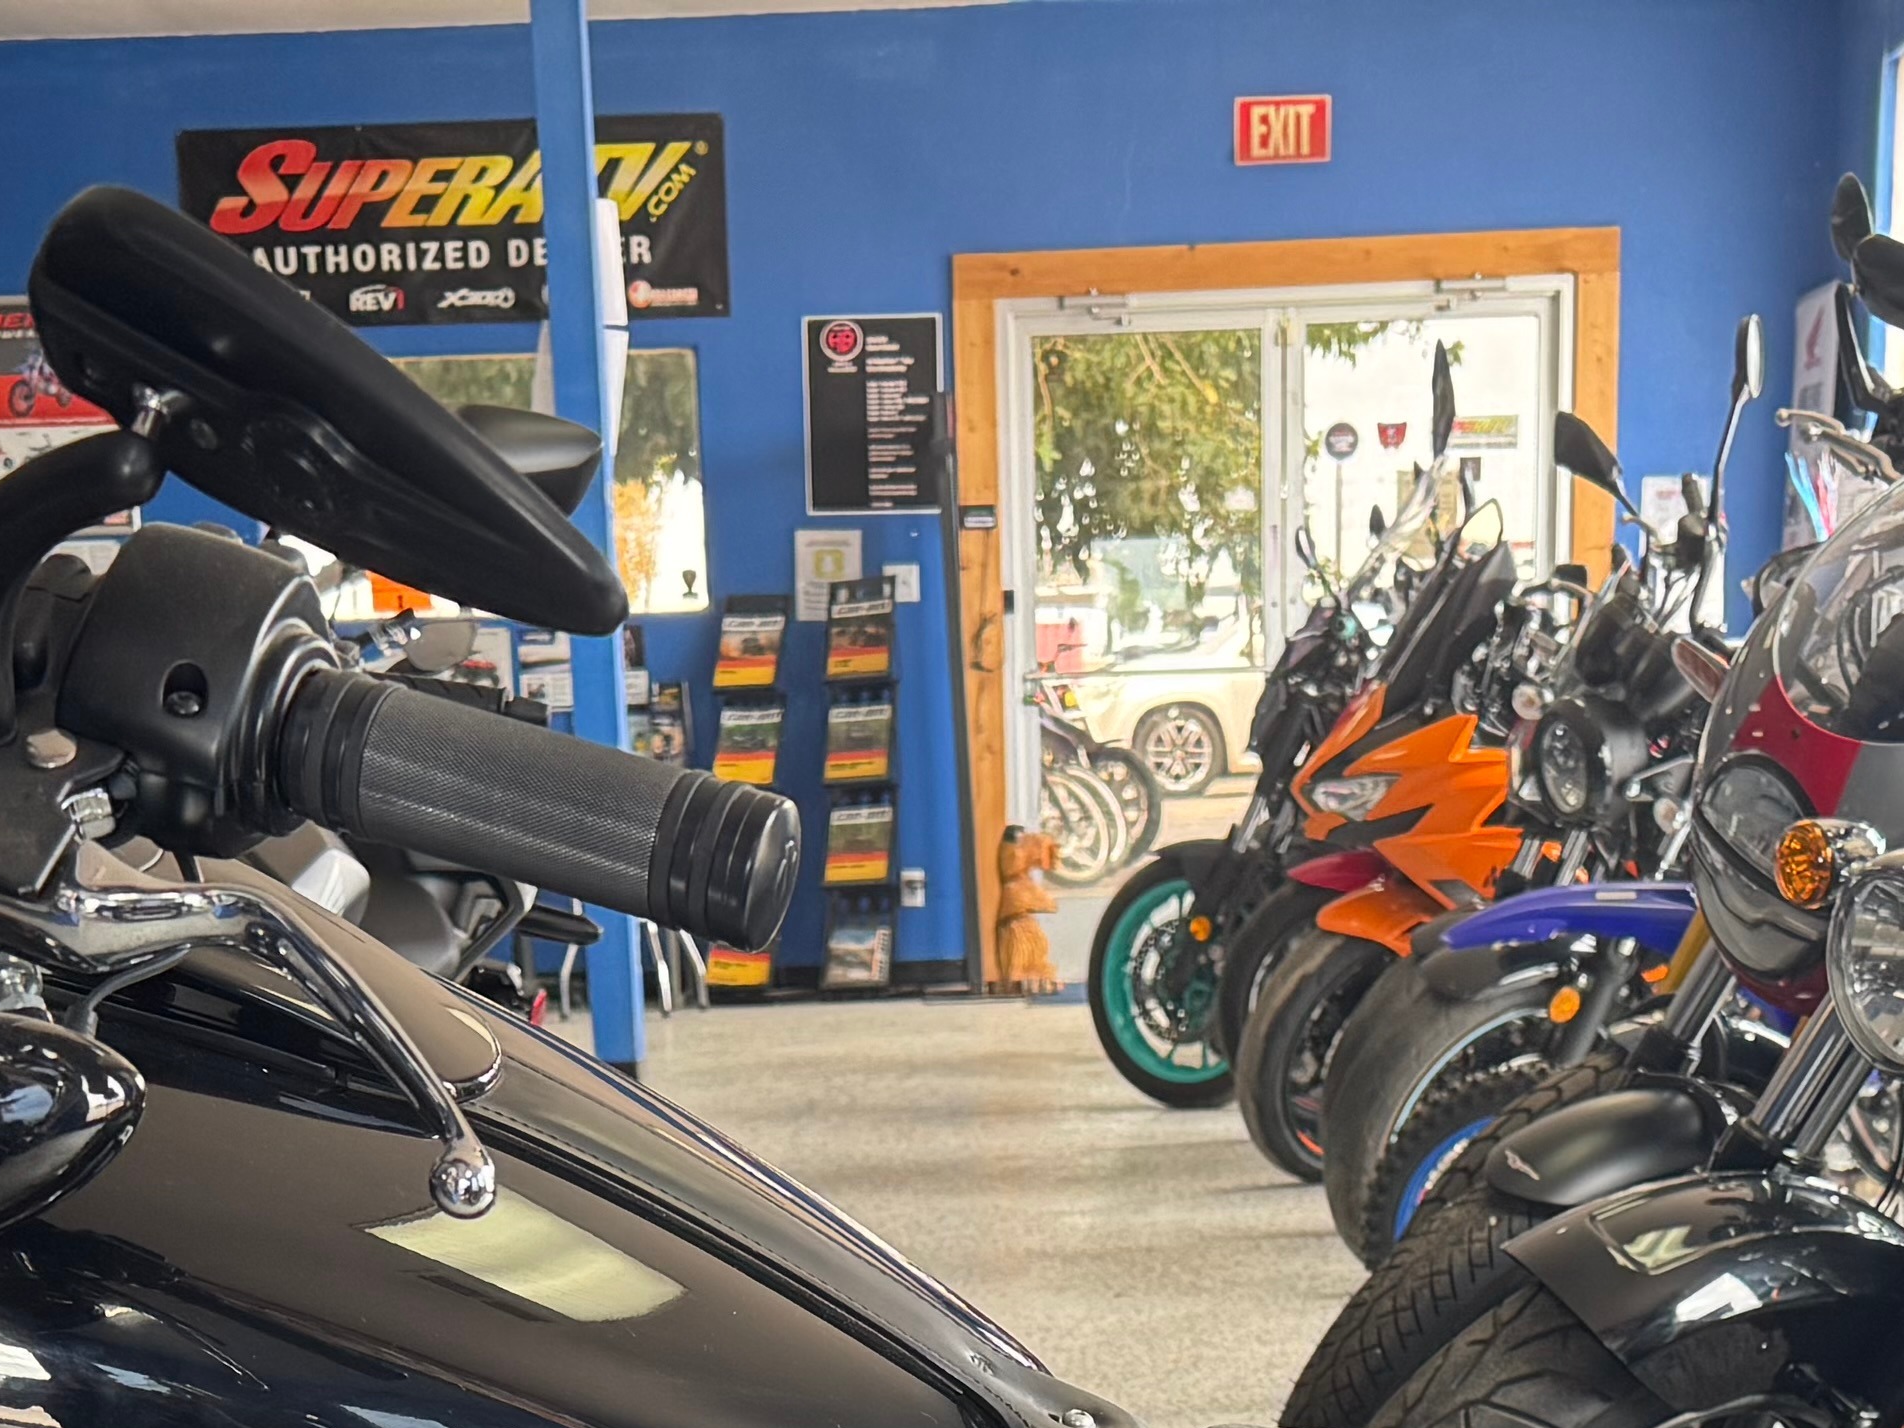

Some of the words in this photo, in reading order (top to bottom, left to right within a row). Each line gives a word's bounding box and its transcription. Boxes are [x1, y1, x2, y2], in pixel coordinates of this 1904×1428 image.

[1249, 103, 1316, 158] EXIT
[253, 240, 490, 278] AUTHORIZED
[508, 236, 653, 269] DER
